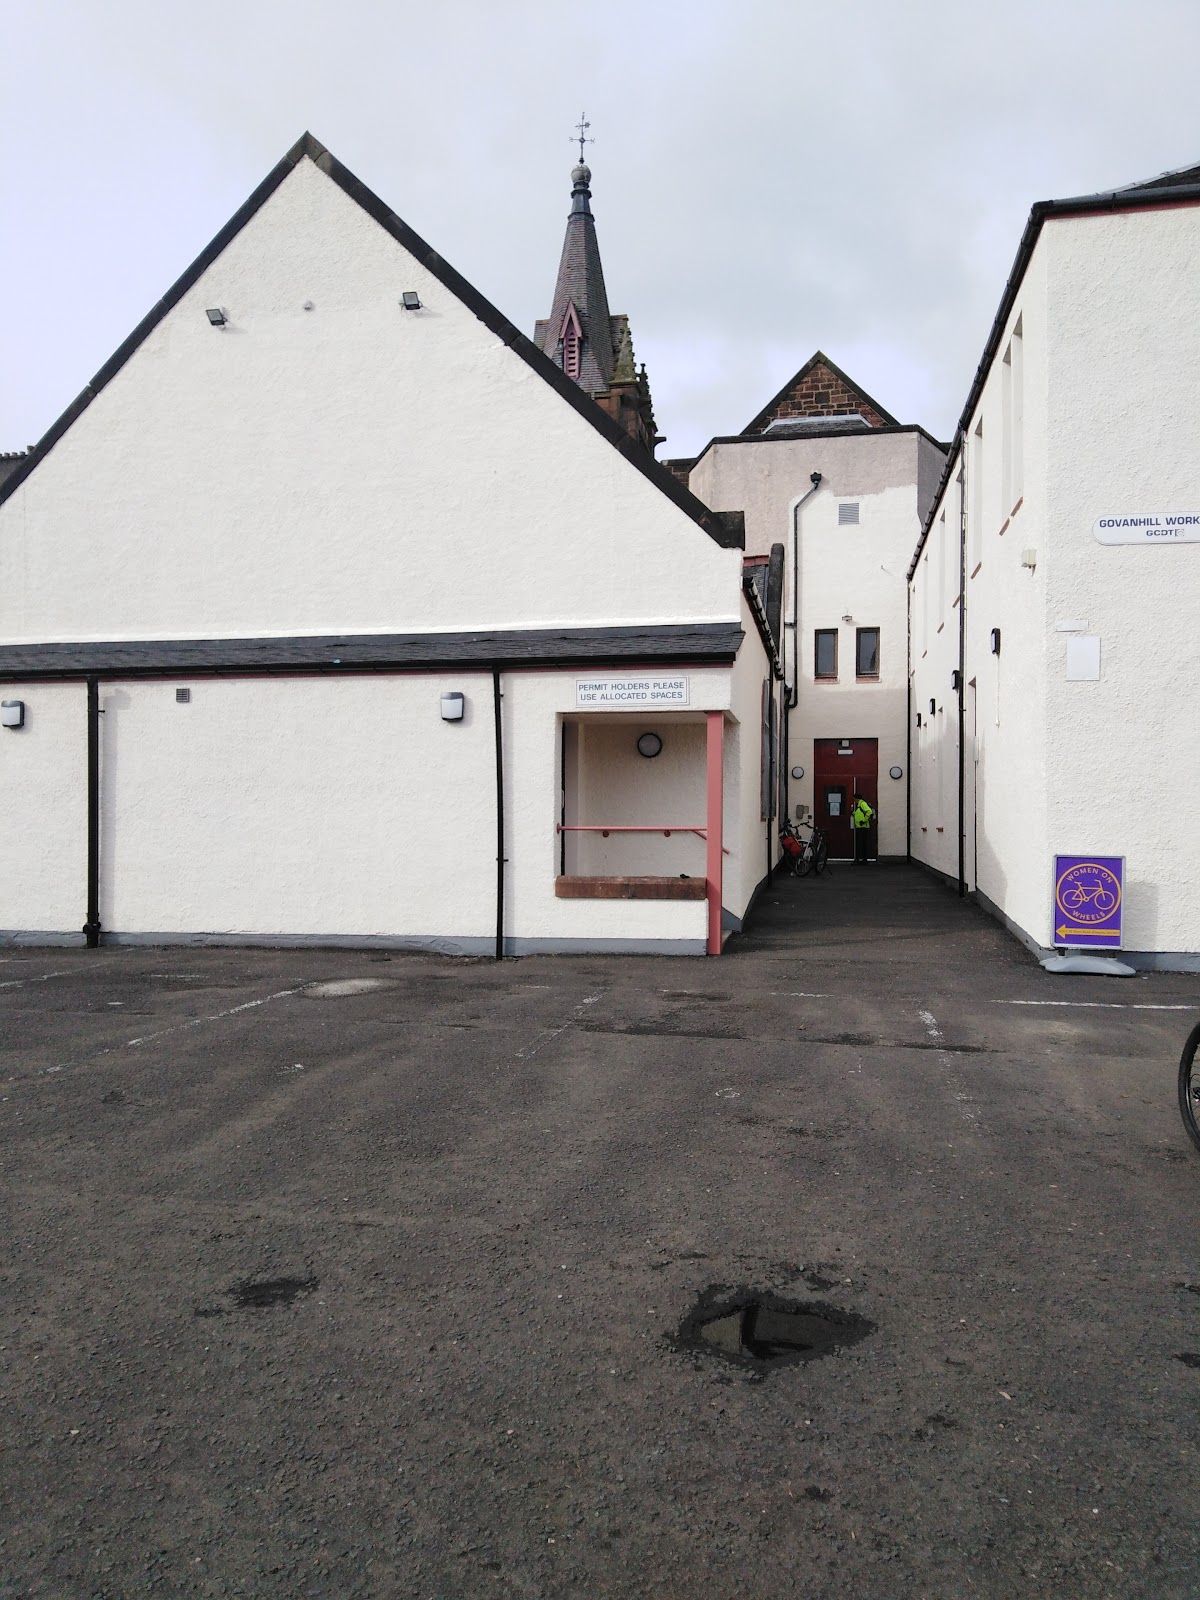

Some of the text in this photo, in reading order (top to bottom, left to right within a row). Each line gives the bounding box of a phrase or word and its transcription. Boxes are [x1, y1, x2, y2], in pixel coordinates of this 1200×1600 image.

[1099, 517, 1161, 528] GOVANHILL
[578, 681, 684, 691] PERMIT HOLDERS PLEASE
[580, 691, 683, 701] USE ALLOCATED SPACES
[1066, 867, 1113, 883] WOMEN ON
[1072, 910, 1106, 920] WHEELS
